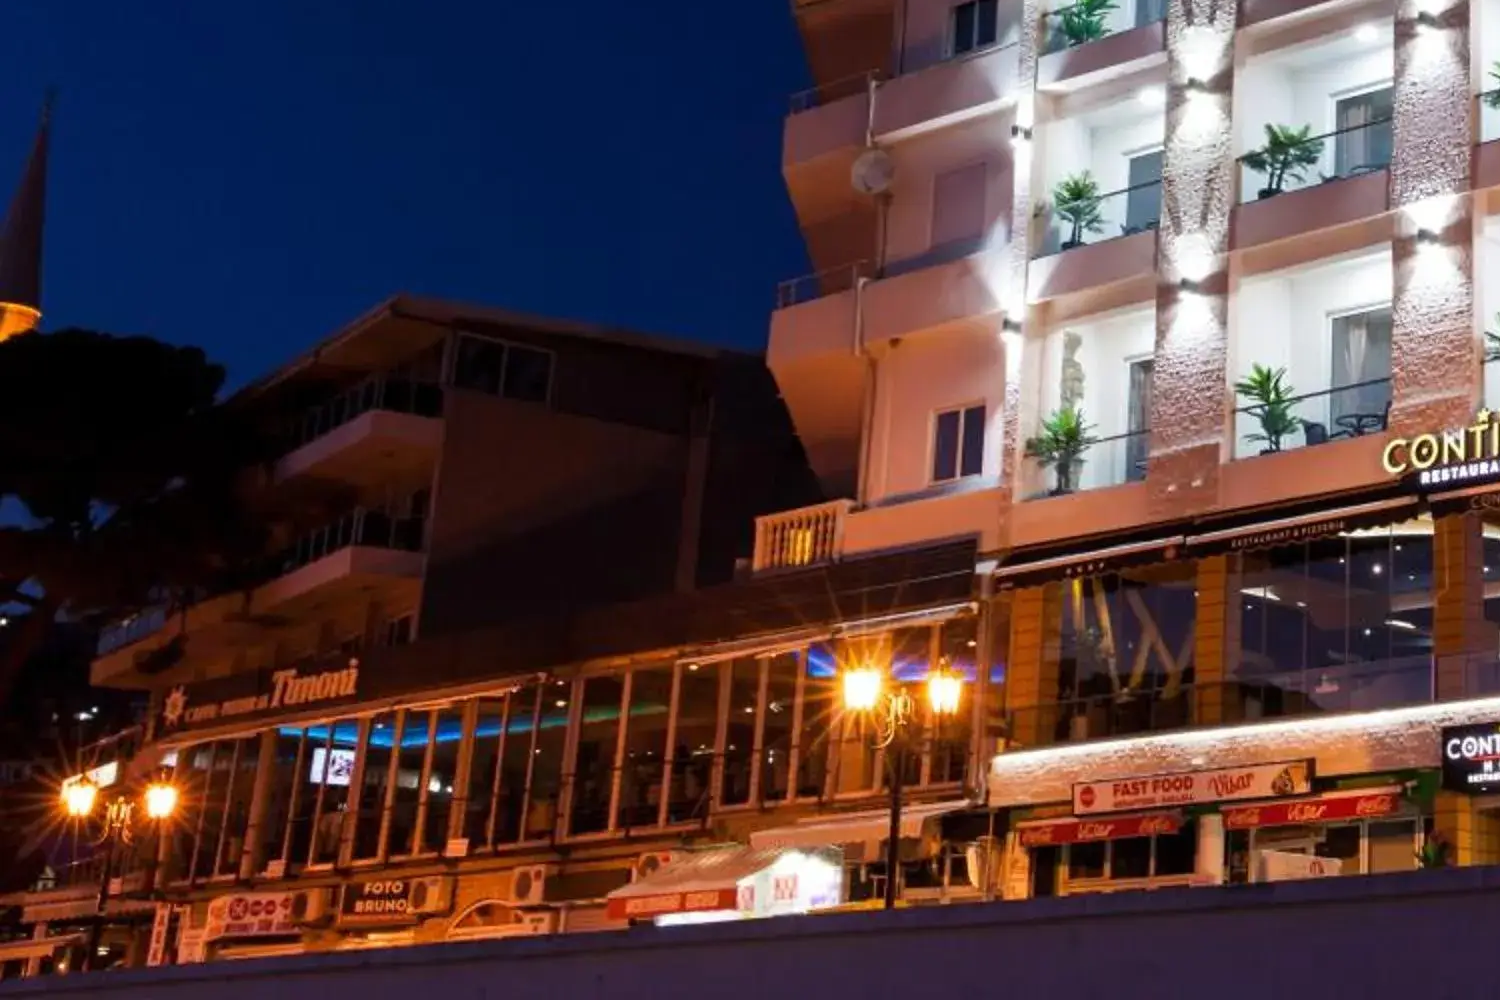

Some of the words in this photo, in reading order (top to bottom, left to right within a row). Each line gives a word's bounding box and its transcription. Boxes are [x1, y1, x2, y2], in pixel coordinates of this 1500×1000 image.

[1112, 780, 1148, 797] FAST
[1152, 776, 1193, 793] FOOD
[363, 880, 404, 895] FOTO
